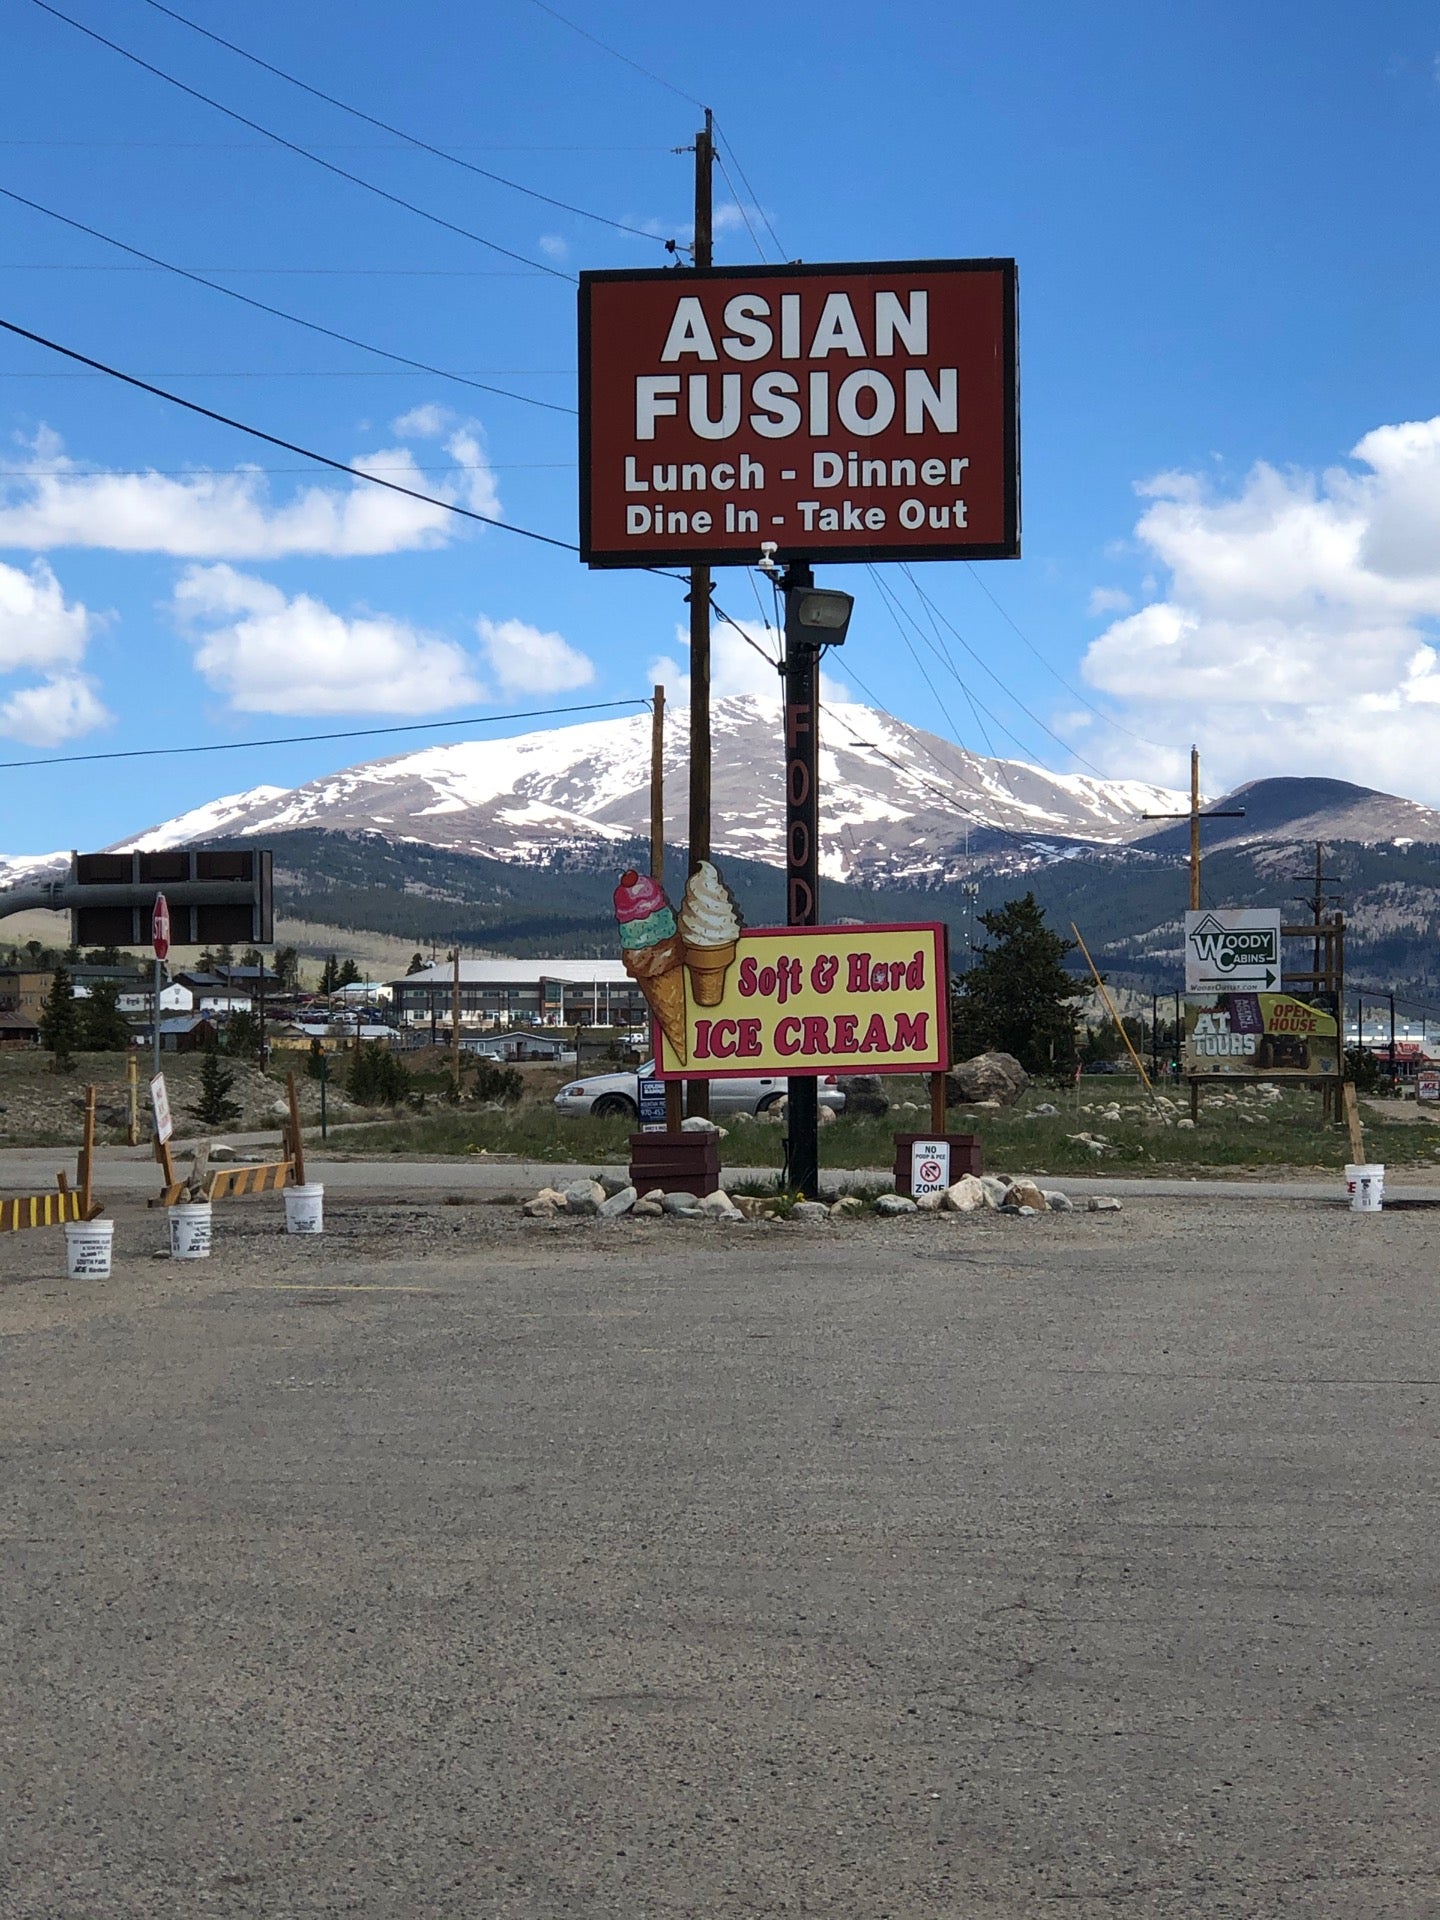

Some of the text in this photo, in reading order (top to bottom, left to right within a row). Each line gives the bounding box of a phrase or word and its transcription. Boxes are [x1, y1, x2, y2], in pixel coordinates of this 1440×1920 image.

[660, 289, 930, 363] ASIAN
[634, 367, 959, 441] FUSION
[624, 450, 970, 493] Lunch - Dinner
[625, 498, 969, 536] Dine In - Take Out
[787, 704, 813, 926] FOOD
[738, 950, 926, 1005] Soft & Hard
[1269, 1018, 1318, 1032] HOUSE
[1273, 1004, 1312, 1018] OPEN
[692, 1011, 930, 1059] ICE CREAM
[1192, 1033, 1255, 1056] TOURS
[925, 1145, 937, 1154] NO
[915, 1183, 945, 1194] ZONE
